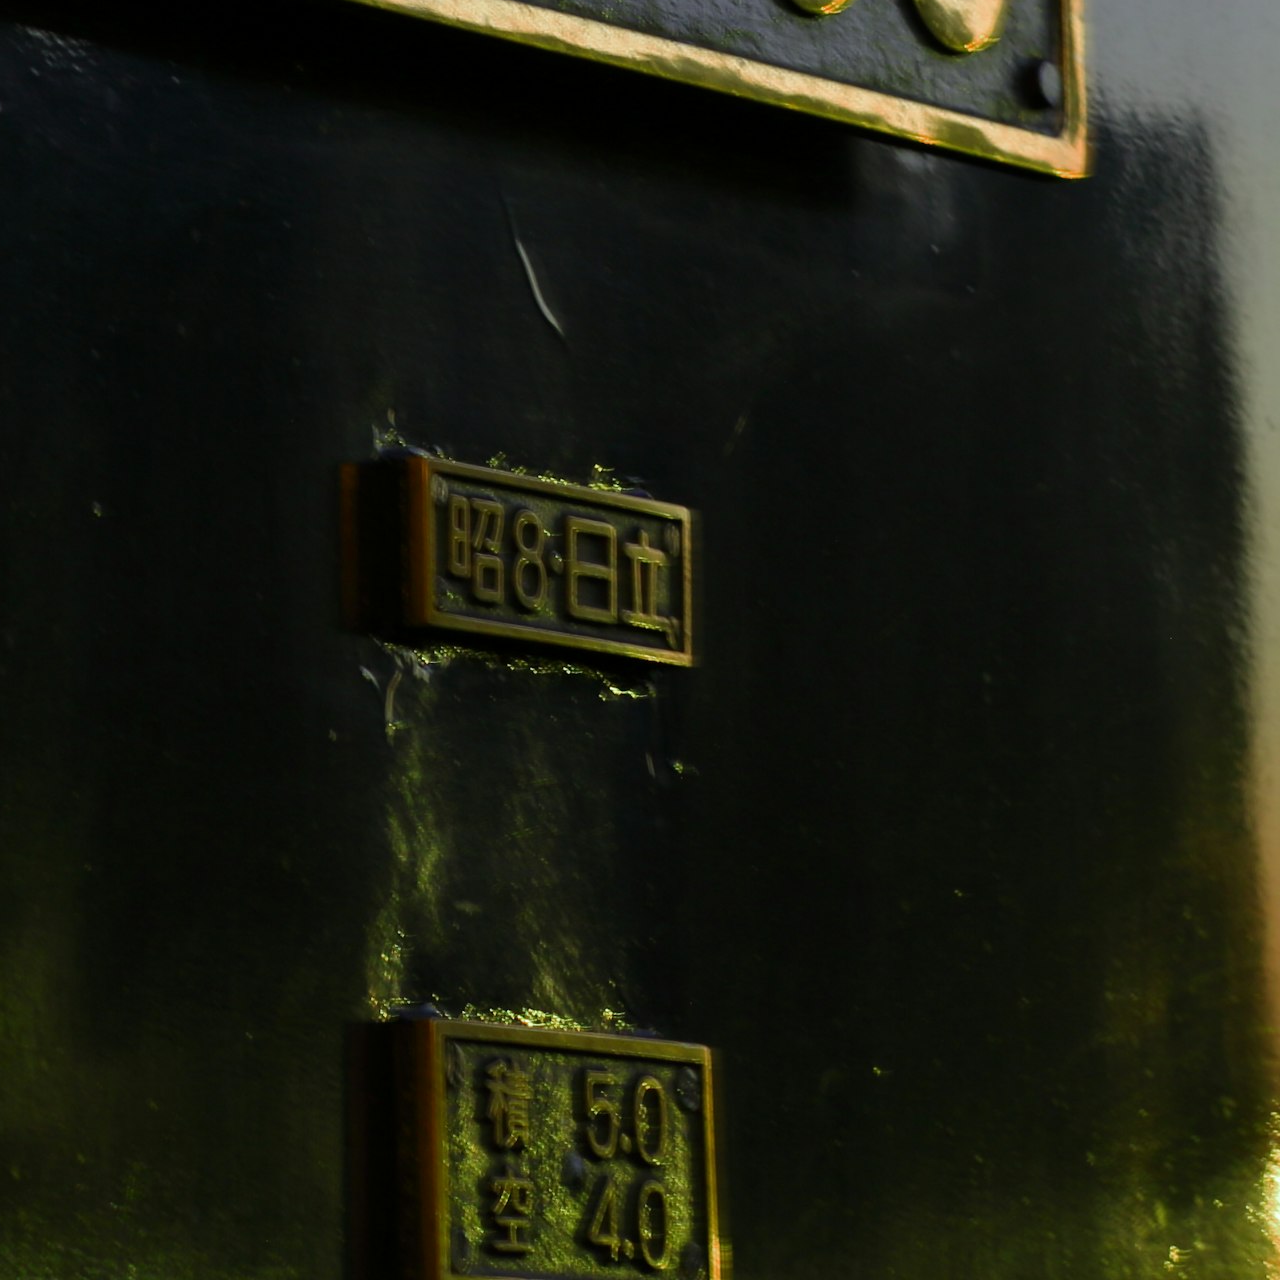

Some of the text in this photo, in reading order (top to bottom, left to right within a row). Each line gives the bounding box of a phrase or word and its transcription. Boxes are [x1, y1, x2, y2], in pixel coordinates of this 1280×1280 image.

[583, 1069, 667, 1166] 5.0
[487, 1164, 671, 1271] 空 4.0
